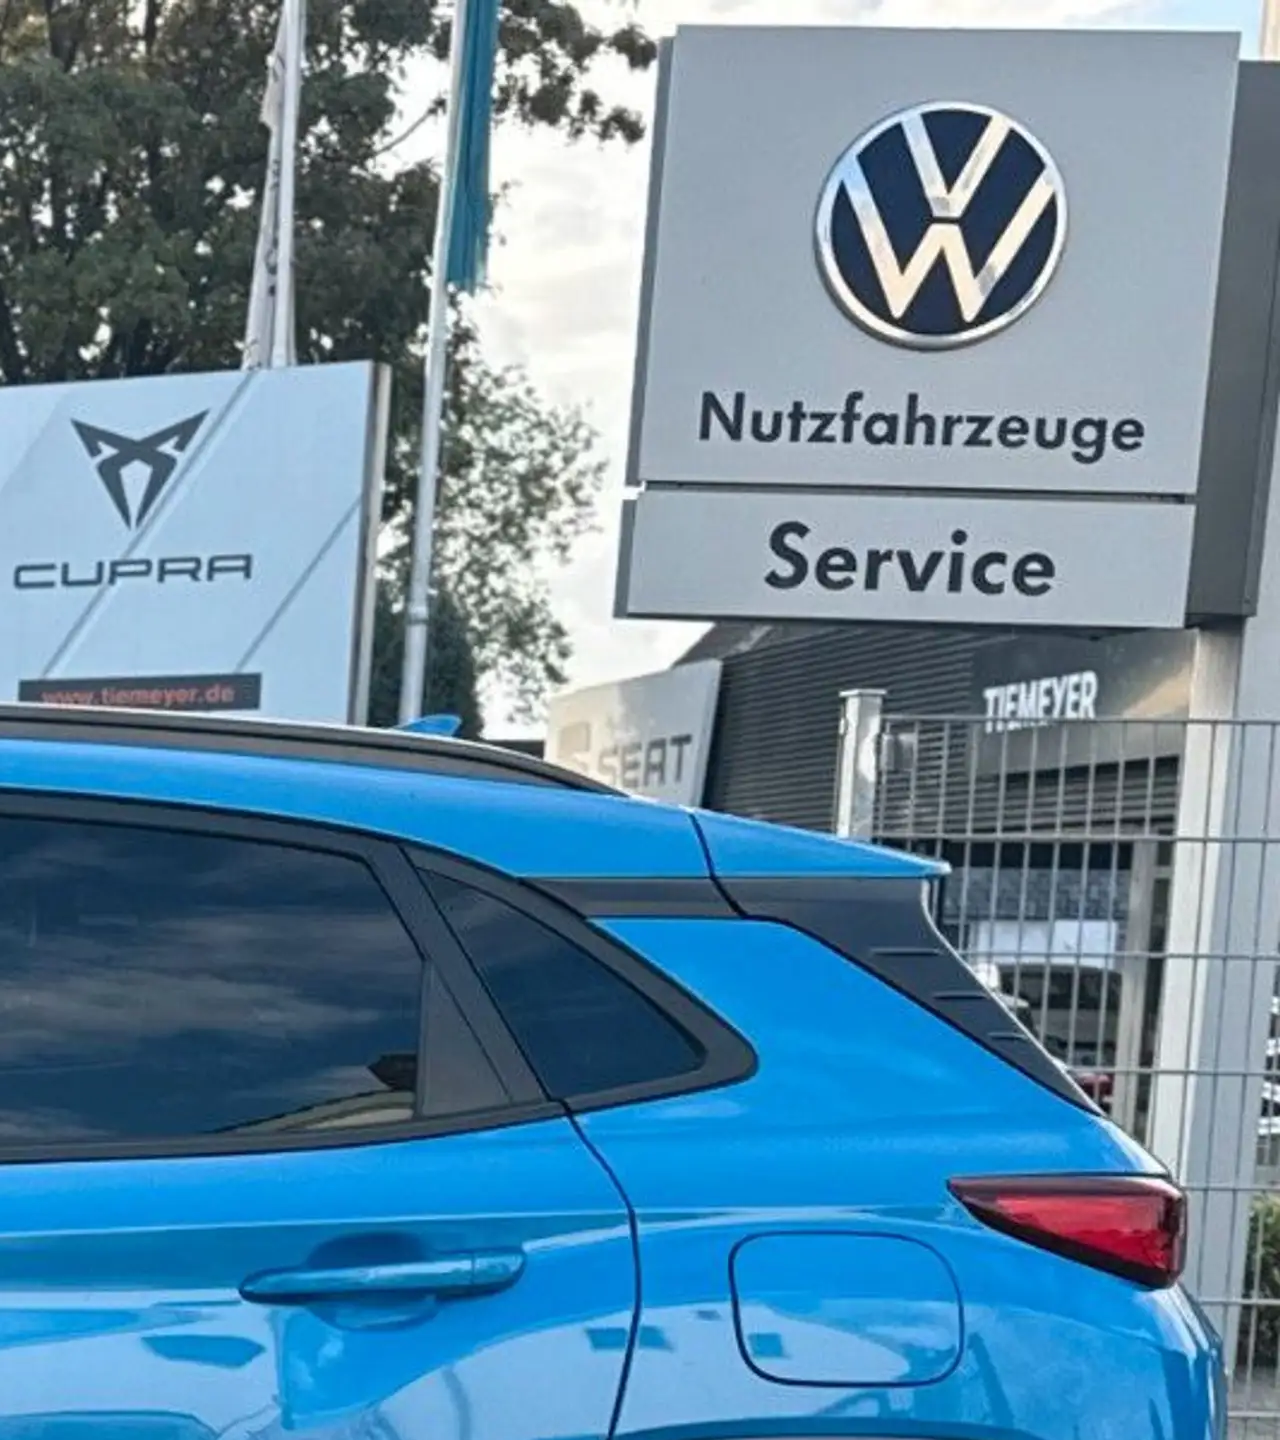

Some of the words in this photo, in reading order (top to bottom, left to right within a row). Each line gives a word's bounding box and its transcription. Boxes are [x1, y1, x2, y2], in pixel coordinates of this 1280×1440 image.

[698, 390, 1146, 465] Nutzfahrzeuge
[12, 553, 253, 590] CUPRA
[763, 521, 1056, 597] Service
[41, 683, 236, 708] www.tiemeyer.de
[983, 670, 1099, 734] TIEMEYER
[597, 733, 693, 788] SEAT
